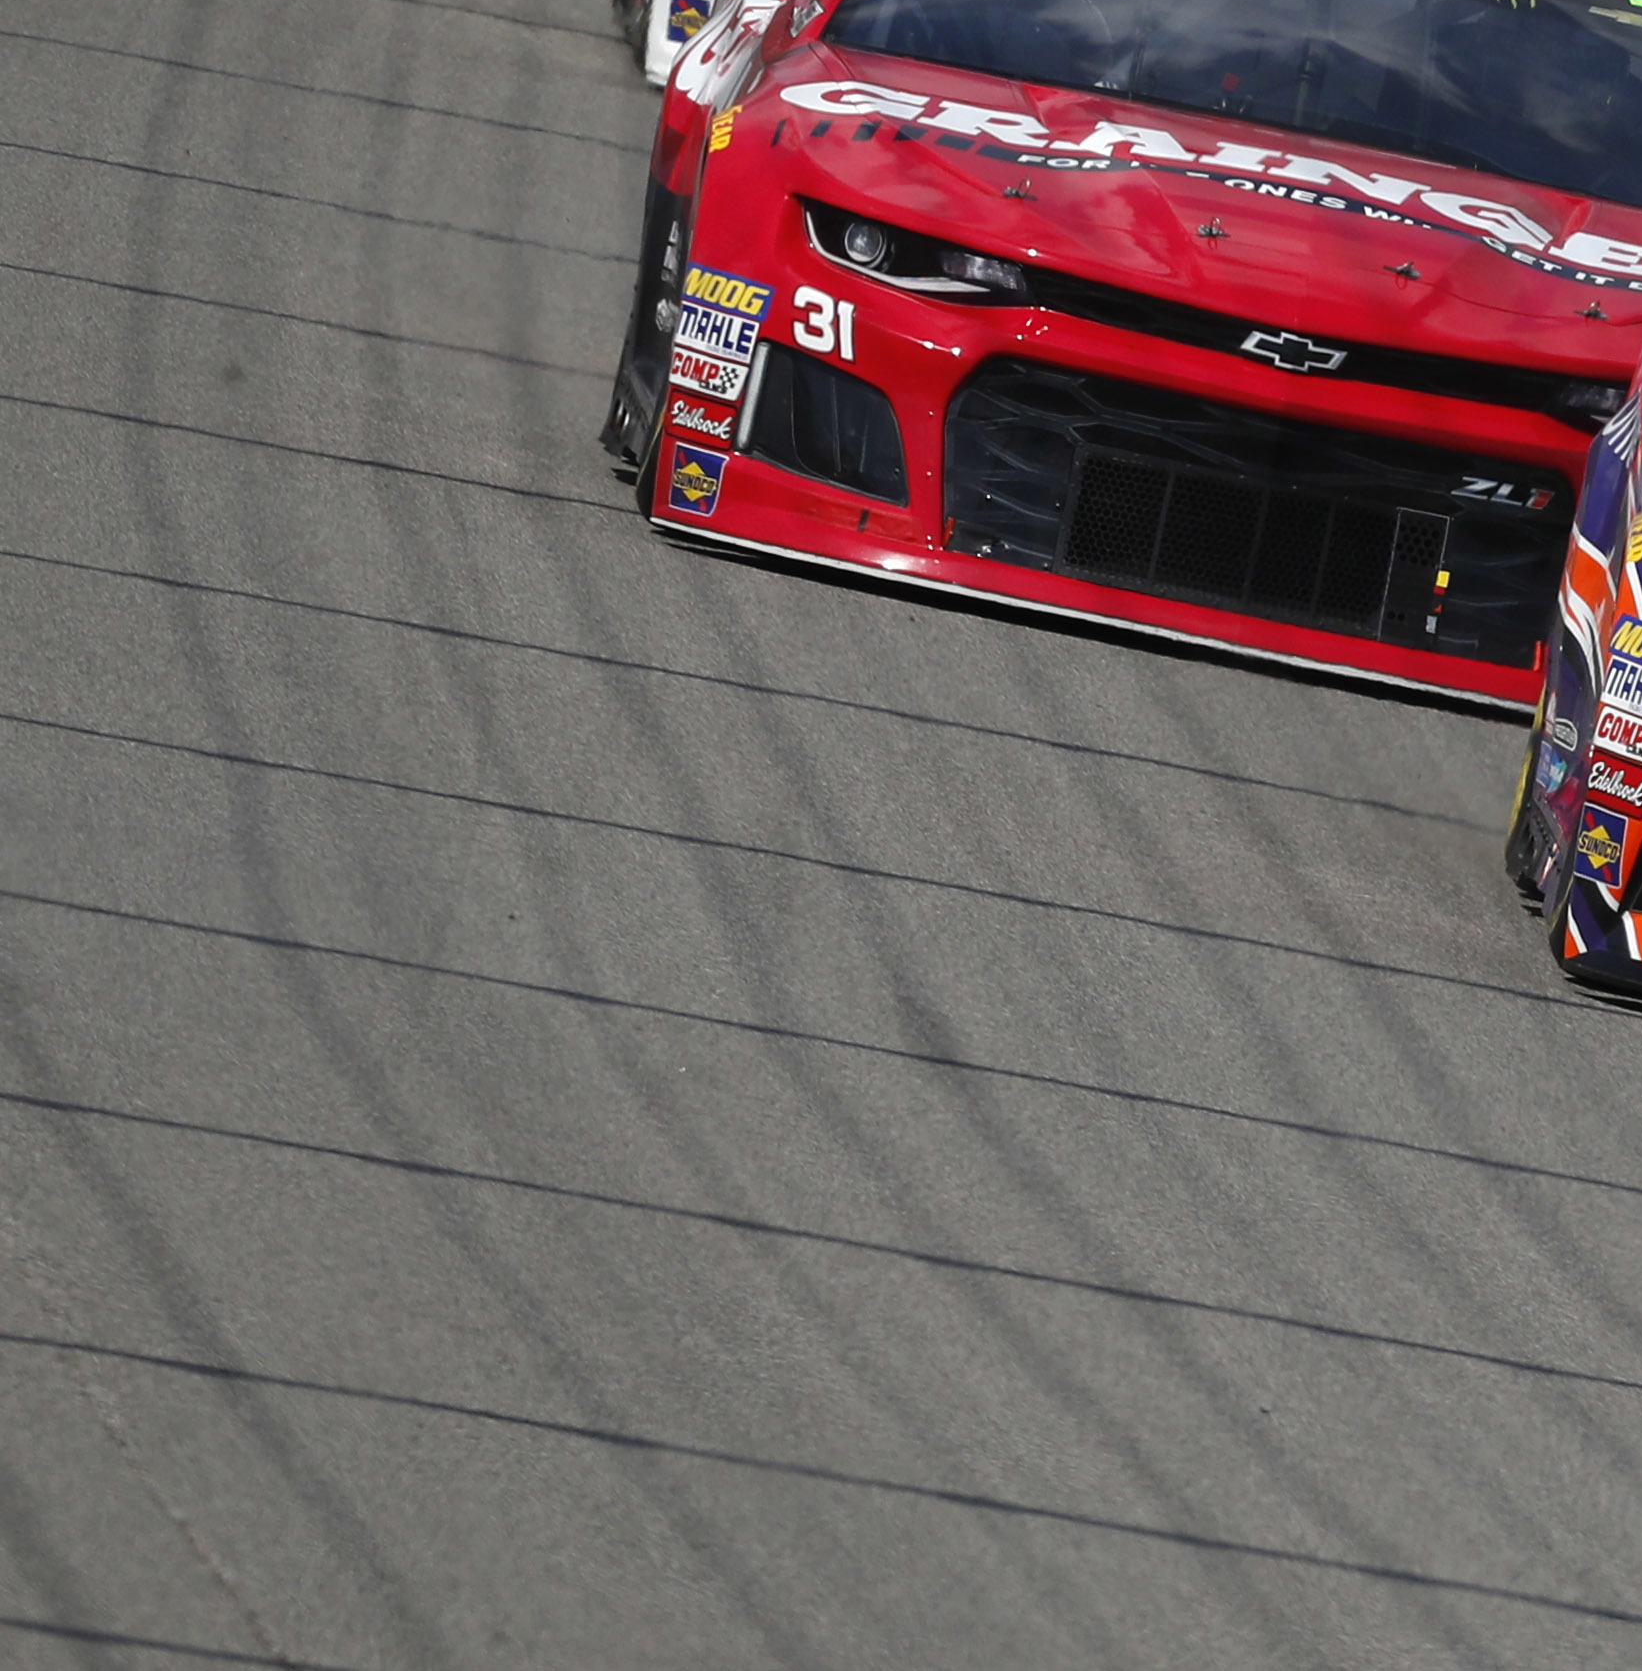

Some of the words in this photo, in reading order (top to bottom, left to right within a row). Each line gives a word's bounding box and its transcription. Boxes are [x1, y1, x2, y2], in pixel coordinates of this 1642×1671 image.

[1016, 154, 1112, 170] FOR
[1223, 179, 1348, 209] ONES
[1480, 236, 1563, 272] GET
[1575, 273, 1615, 286] IT
[684, 269, 771, 315] MOOG
[680, 304, 755, 353] MAHLE
[792, 285, 857, 362] 31
[671, 352, 719, 380] COMP
[670, 399, 733, 442] Edelbrock
[673, 471, 719, 496] SUNOCO
[1452, 476, 1554, 509] ZL1
[1578, 832, 1621, 862] SUNOCO
